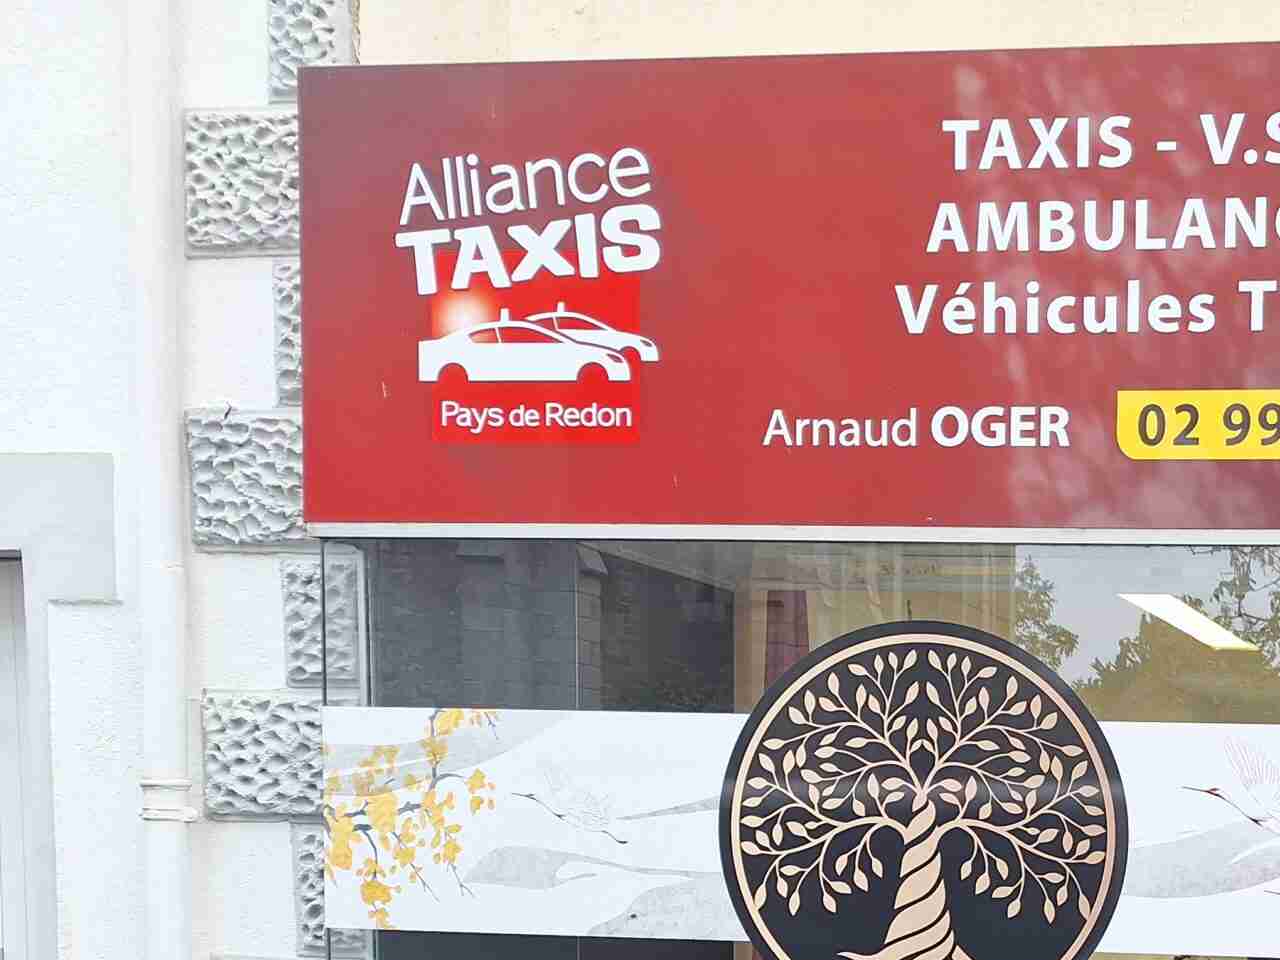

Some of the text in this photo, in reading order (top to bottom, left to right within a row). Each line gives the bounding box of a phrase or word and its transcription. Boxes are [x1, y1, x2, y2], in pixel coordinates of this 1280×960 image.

[942, 116, 1132, 170] TAXIS
[1157, 139, 1177, 152] -
[400, 147, 651, 225] Alliance
[395, 203, 661, 295] TAXIS
[895, 279, 1216, 335] Véhicules
[441, 401, 633, 434] Pays de Redon
[763, 405, 1070, 449] Arnaud OGER
[1137, 404, 1200, 446] 02
